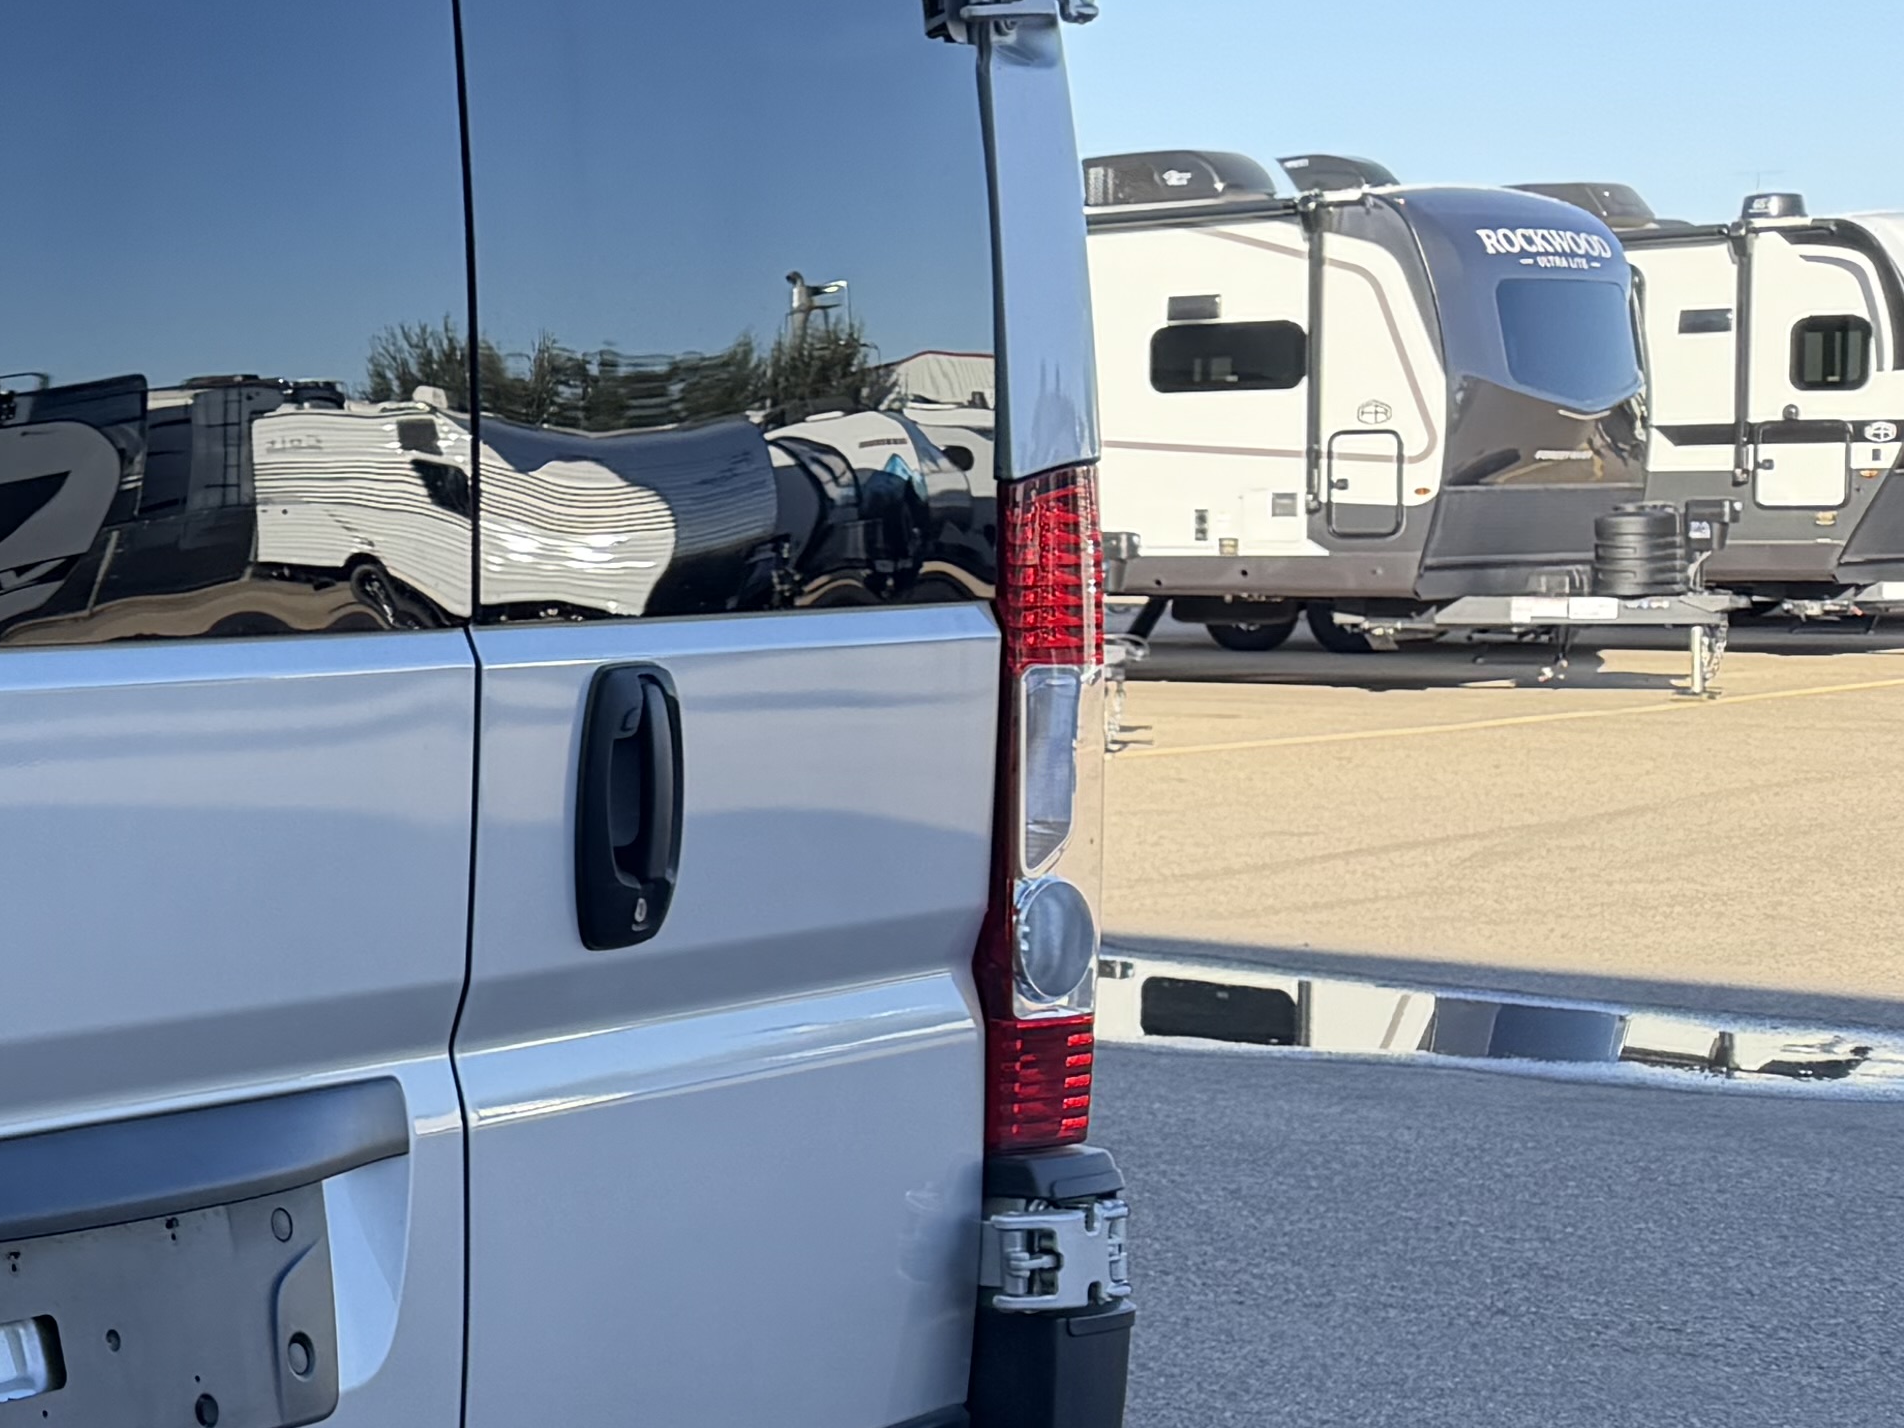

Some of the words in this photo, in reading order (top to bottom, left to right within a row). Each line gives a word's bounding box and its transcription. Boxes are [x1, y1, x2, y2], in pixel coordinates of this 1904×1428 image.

[1475, 228, 1612, 258] ROCKWOOD
[1537, 255, 1569, 268] ULTRA
[1569, 256, 1589, 269] LITE
